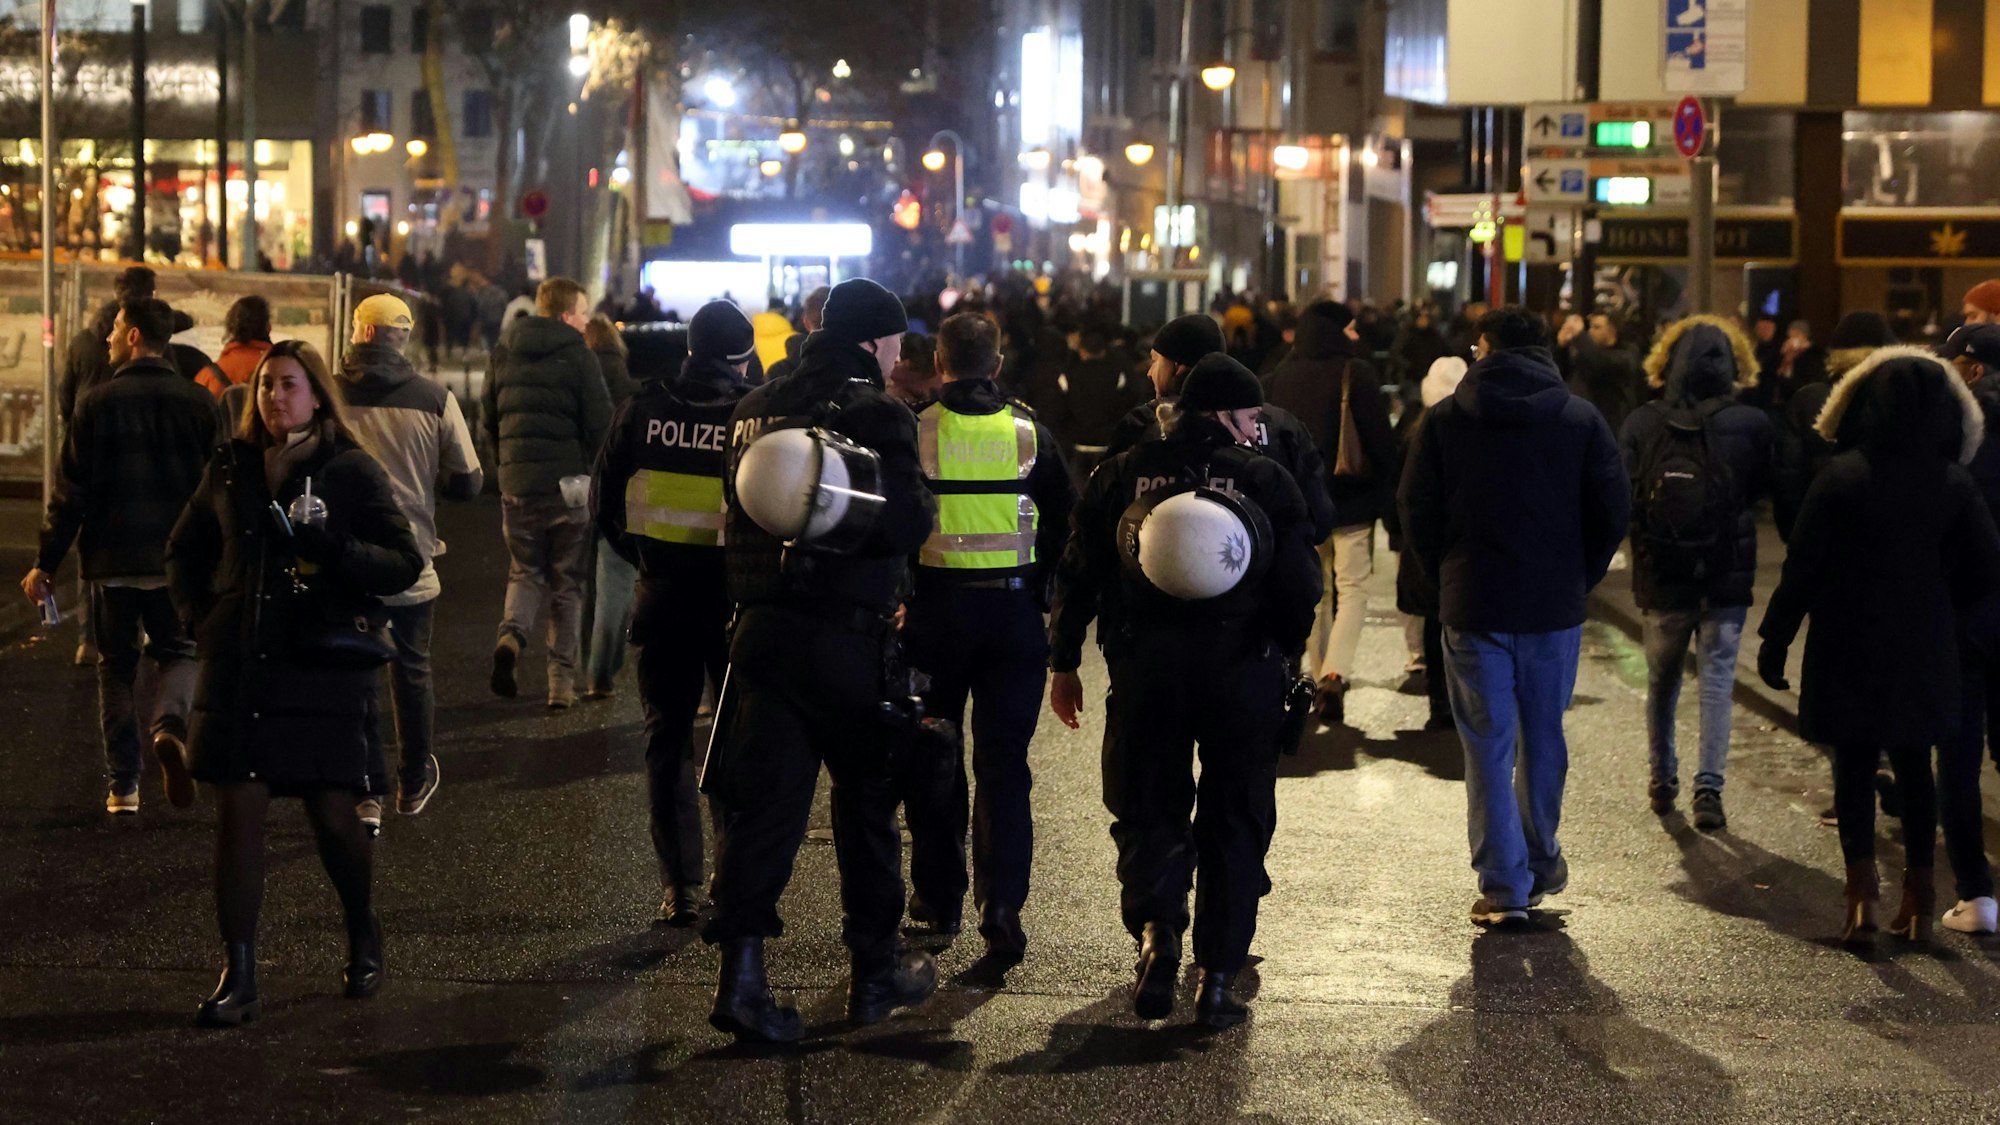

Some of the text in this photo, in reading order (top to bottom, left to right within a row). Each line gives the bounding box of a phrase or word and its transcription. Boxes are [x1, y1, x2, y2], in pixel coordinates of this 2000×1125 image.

[1608, 227, 1749, 248] HONEOT
[646, 418, 727, 451] POLIZE
[944, 439, 1013, 463] POLIZEI
